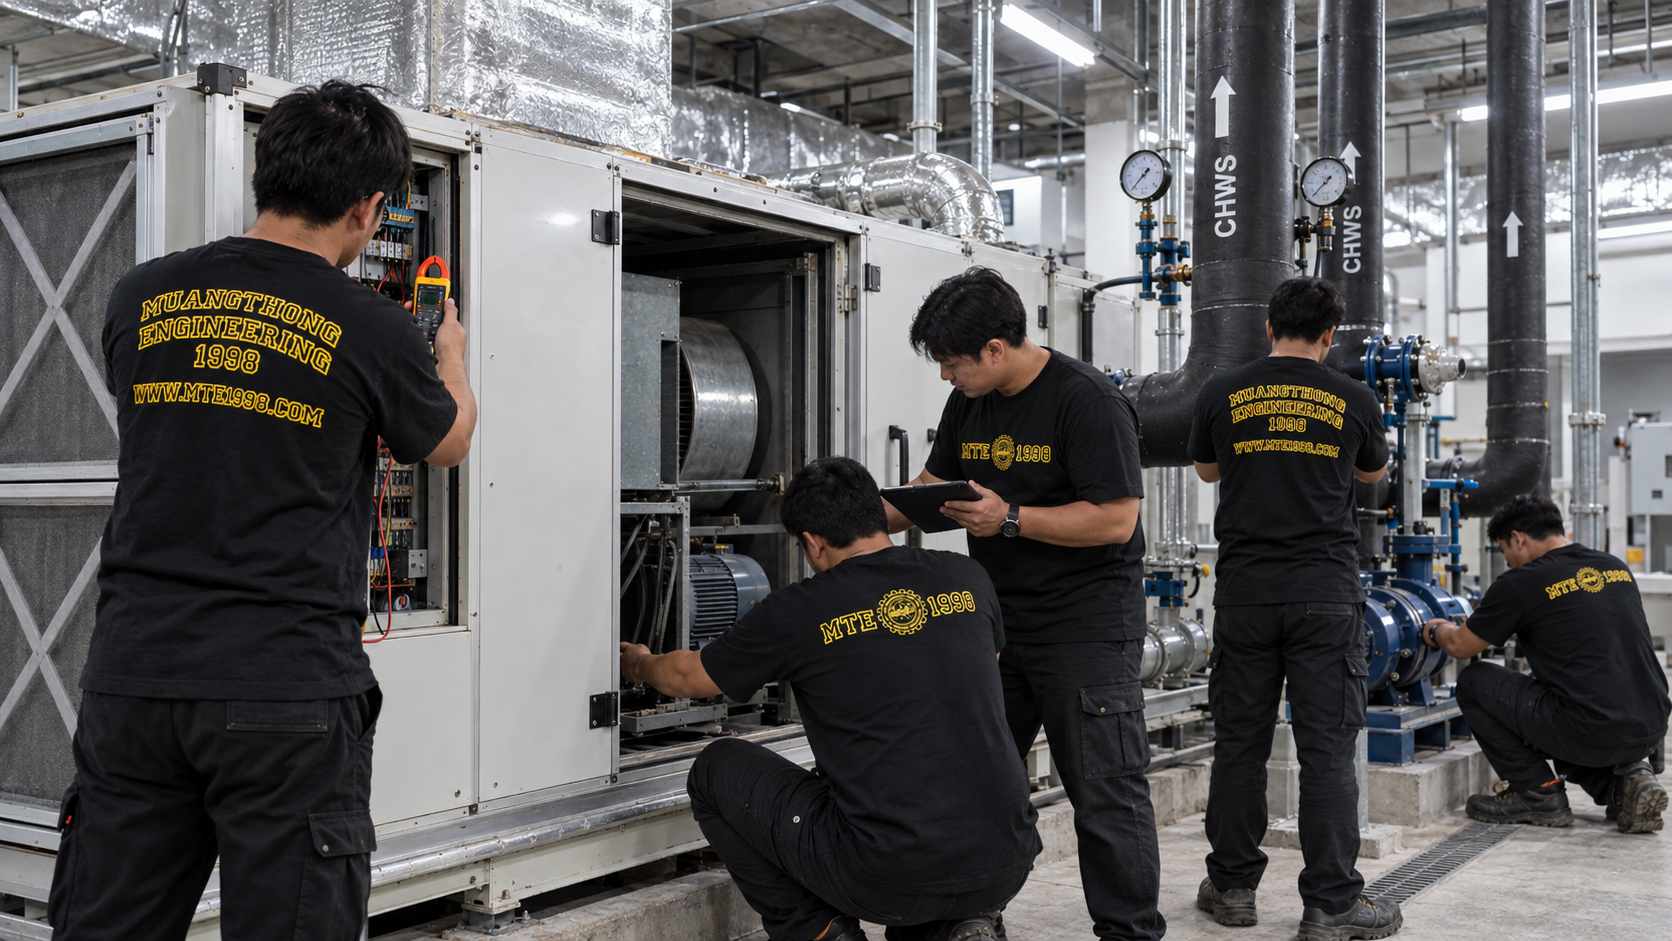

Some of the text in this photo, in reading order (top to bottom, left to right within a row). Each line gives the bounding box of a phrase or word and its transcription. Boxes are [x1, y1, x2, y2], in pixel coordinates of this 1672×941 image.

[1214, 154, 1237, 238] CHWS
[1343, 205, 1362, 274] CHWS
[138, 315, 333, 375] ENGINEERING
[141, 289, 342, 348] MUANGTHONG
[193, 343, 261, 375] 1998
[133, 382, 325, 428] WWW.MTE1998.COM
[961, 443, 991, 460] MTE
[1545, 577, 1580, 600] MTE
[819, 590, 977, 645] MTE 1998
